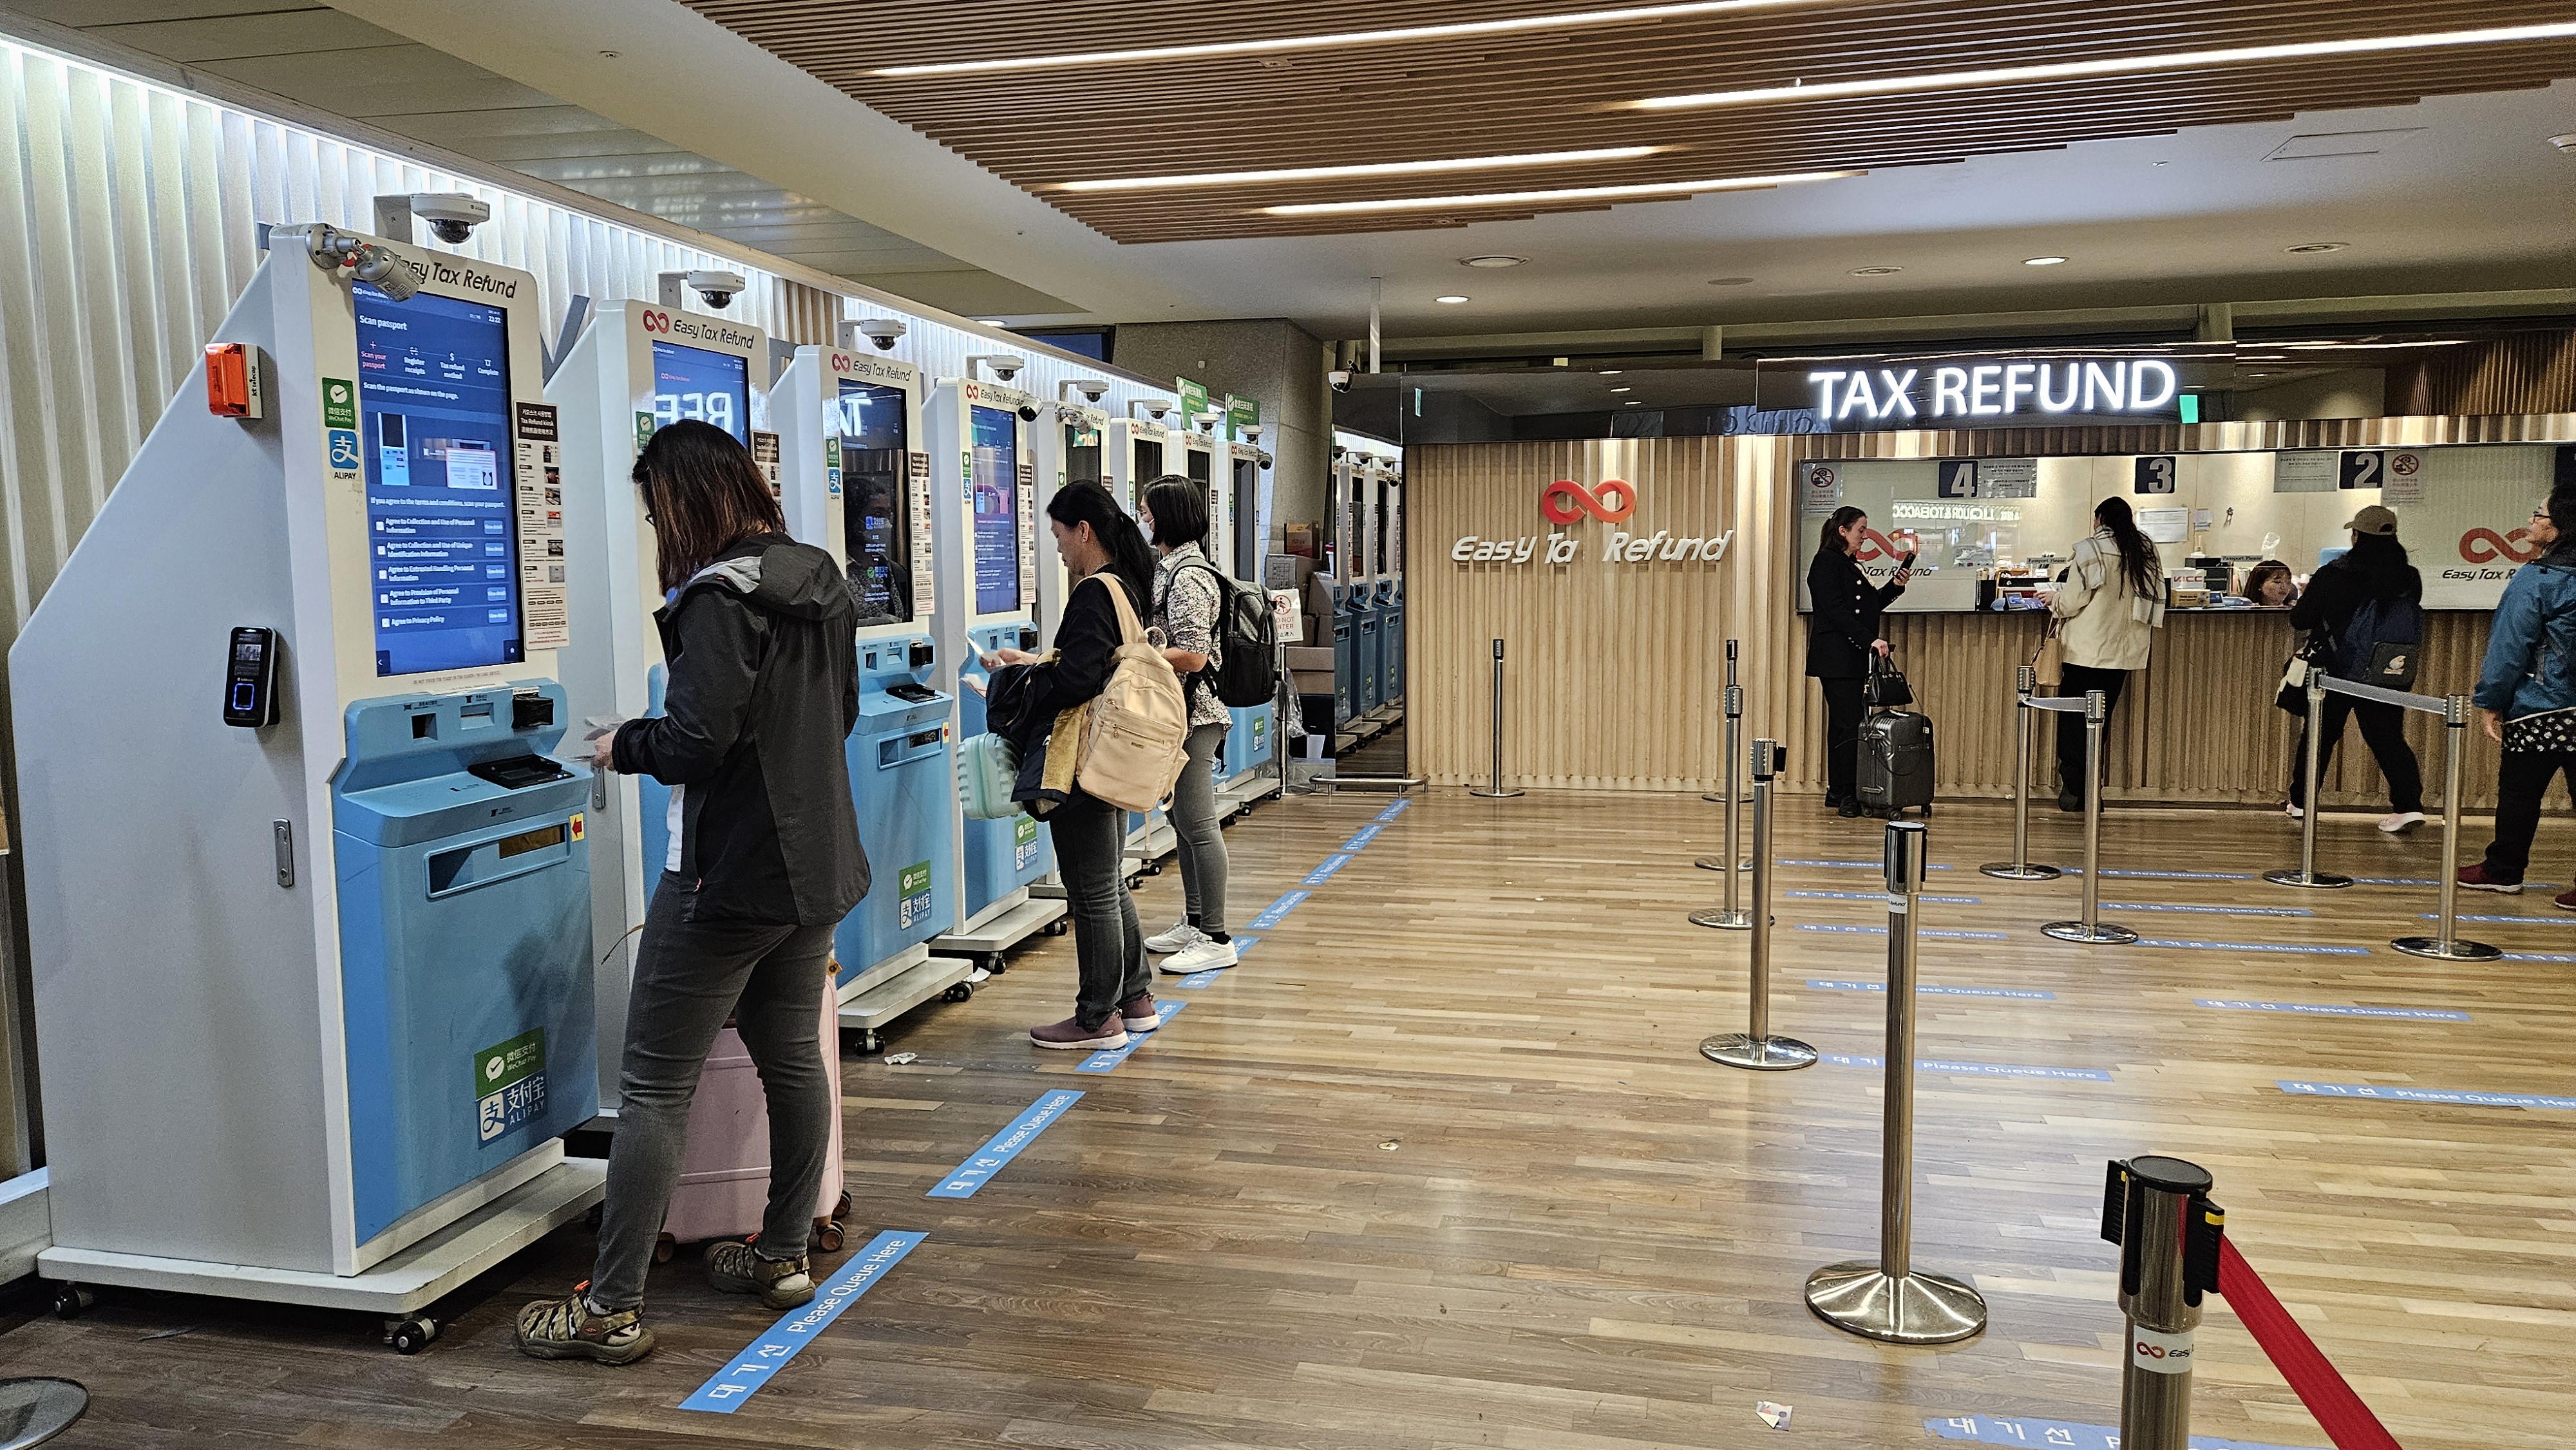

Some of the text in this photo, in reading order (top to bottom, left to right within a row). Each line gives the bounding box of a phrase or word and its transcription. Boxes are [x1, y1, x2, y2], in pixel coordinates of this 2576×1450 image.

[395, 255, 516, 299] sy Tax Refund
[359, 315, 408, 331] Scan passport
[674, 319, 754, 349] Easy Tax Refund
[363, 361, 386, 370] passport
[853, 361, 912, 382] Easy Tax Refund
[363, 382, 377, 390] Scan
[386, 385, 408, 394] passport
[980, 390, 992, 402] Easy
[993, 391, 1002, 402] Tax
[1808, 360, 2177, 420] TAX REFUND
[1091, 414, 1104, 426] Refund
[1951, 463, 1975, 498] 4
[2148, 458, 2172, 493] 3
[2354, 453, 2378, 489] 2
[1451, 530, 1734, 564] Easy Ta Refund
[1866, 567, 1888, 576] Tax
[2442, 569, 2477, 581] Easy
[2479, 569, 2503, 579] Tax
[913, 893, 930, 914] 支付宝
[914, 909, 930, 922] ALIPAY
[2266, 945, 2317, 953] Queue
[2293, 1005, 2347, 1014] Please
[2351, 1008, 2410, 1017] Queue
[2414, 1010, 2458, 1019] Here
[507, 1042, 536, 1063] 微信支付
[1833, 1056, 2097, 1078] 대기 Please Queue Here
[507, 1077, 545, 1115] 支付宝
[2395, 1089, 2459, 1101] Please
[2464, 1094, 2534, 1106] Queue
[509, 1100, 545, 1125] ALIPAY
[992, 1129, 1030, 1153] Please
[1019, 1111, 1049, 1130] Queue
[1042, 1095, 1070, 1110] Here
[786, 1297, 841, 1333] Please
[830, 1263, 880, 1295] Queue
[867, 1240, 906, 1263] Here
[1948, 1418, 2076, 1446] 대기선
